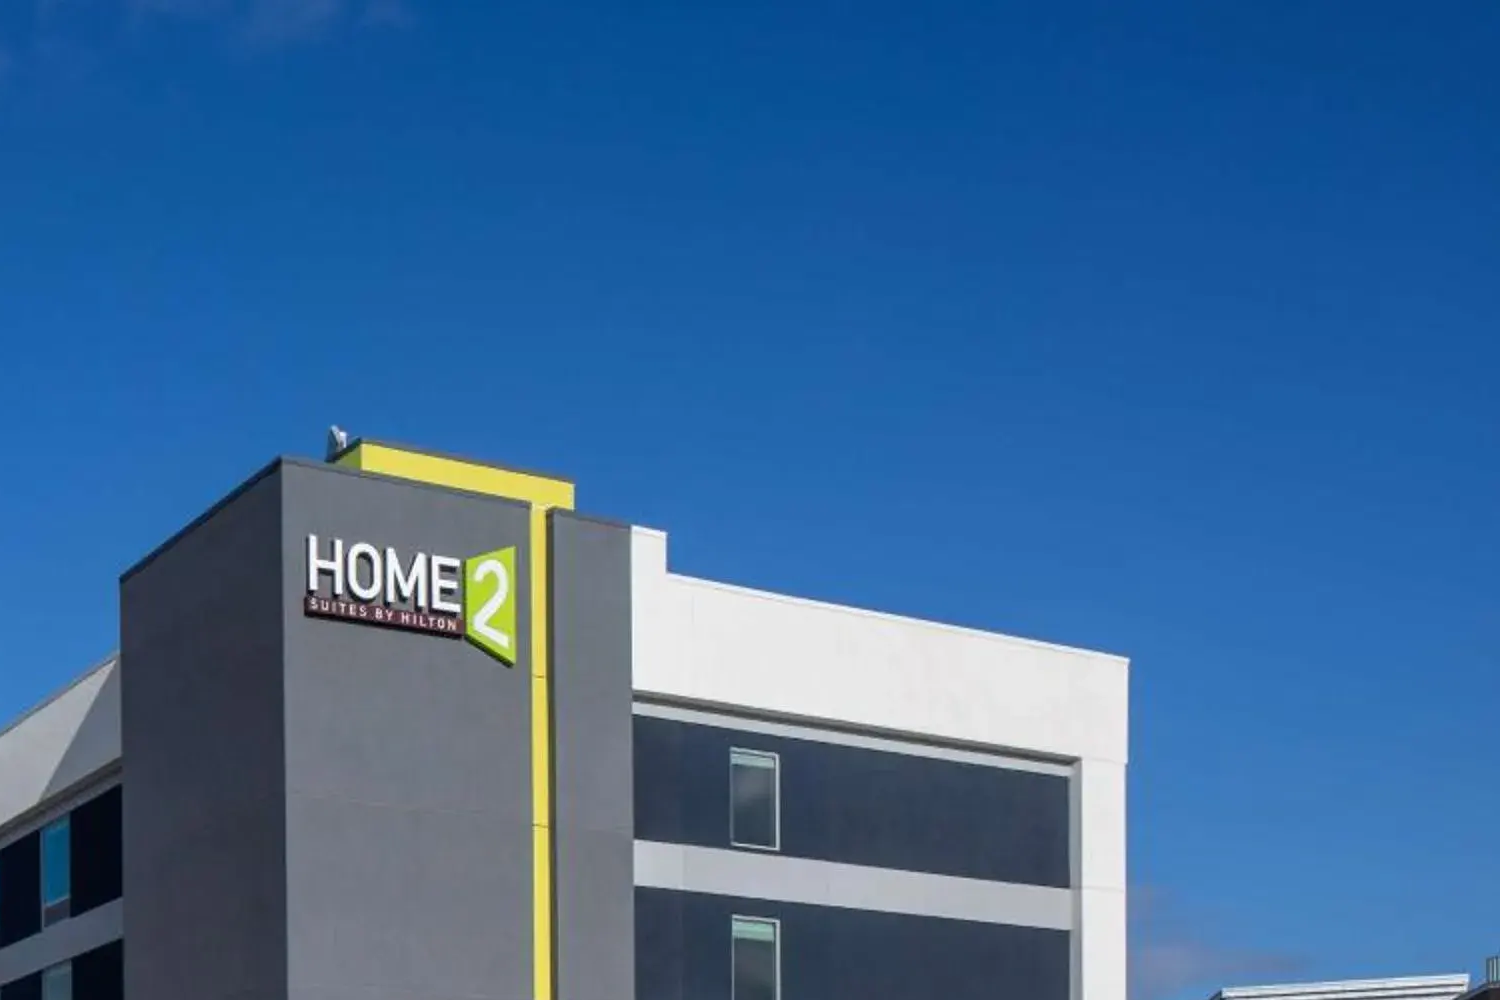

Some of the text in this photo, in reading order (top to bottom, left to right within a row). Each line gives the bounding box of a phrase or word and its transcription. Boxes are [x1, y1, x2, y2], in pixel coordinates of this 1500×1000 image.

[310, 598, 457, 631] SUITES BY HILTON
